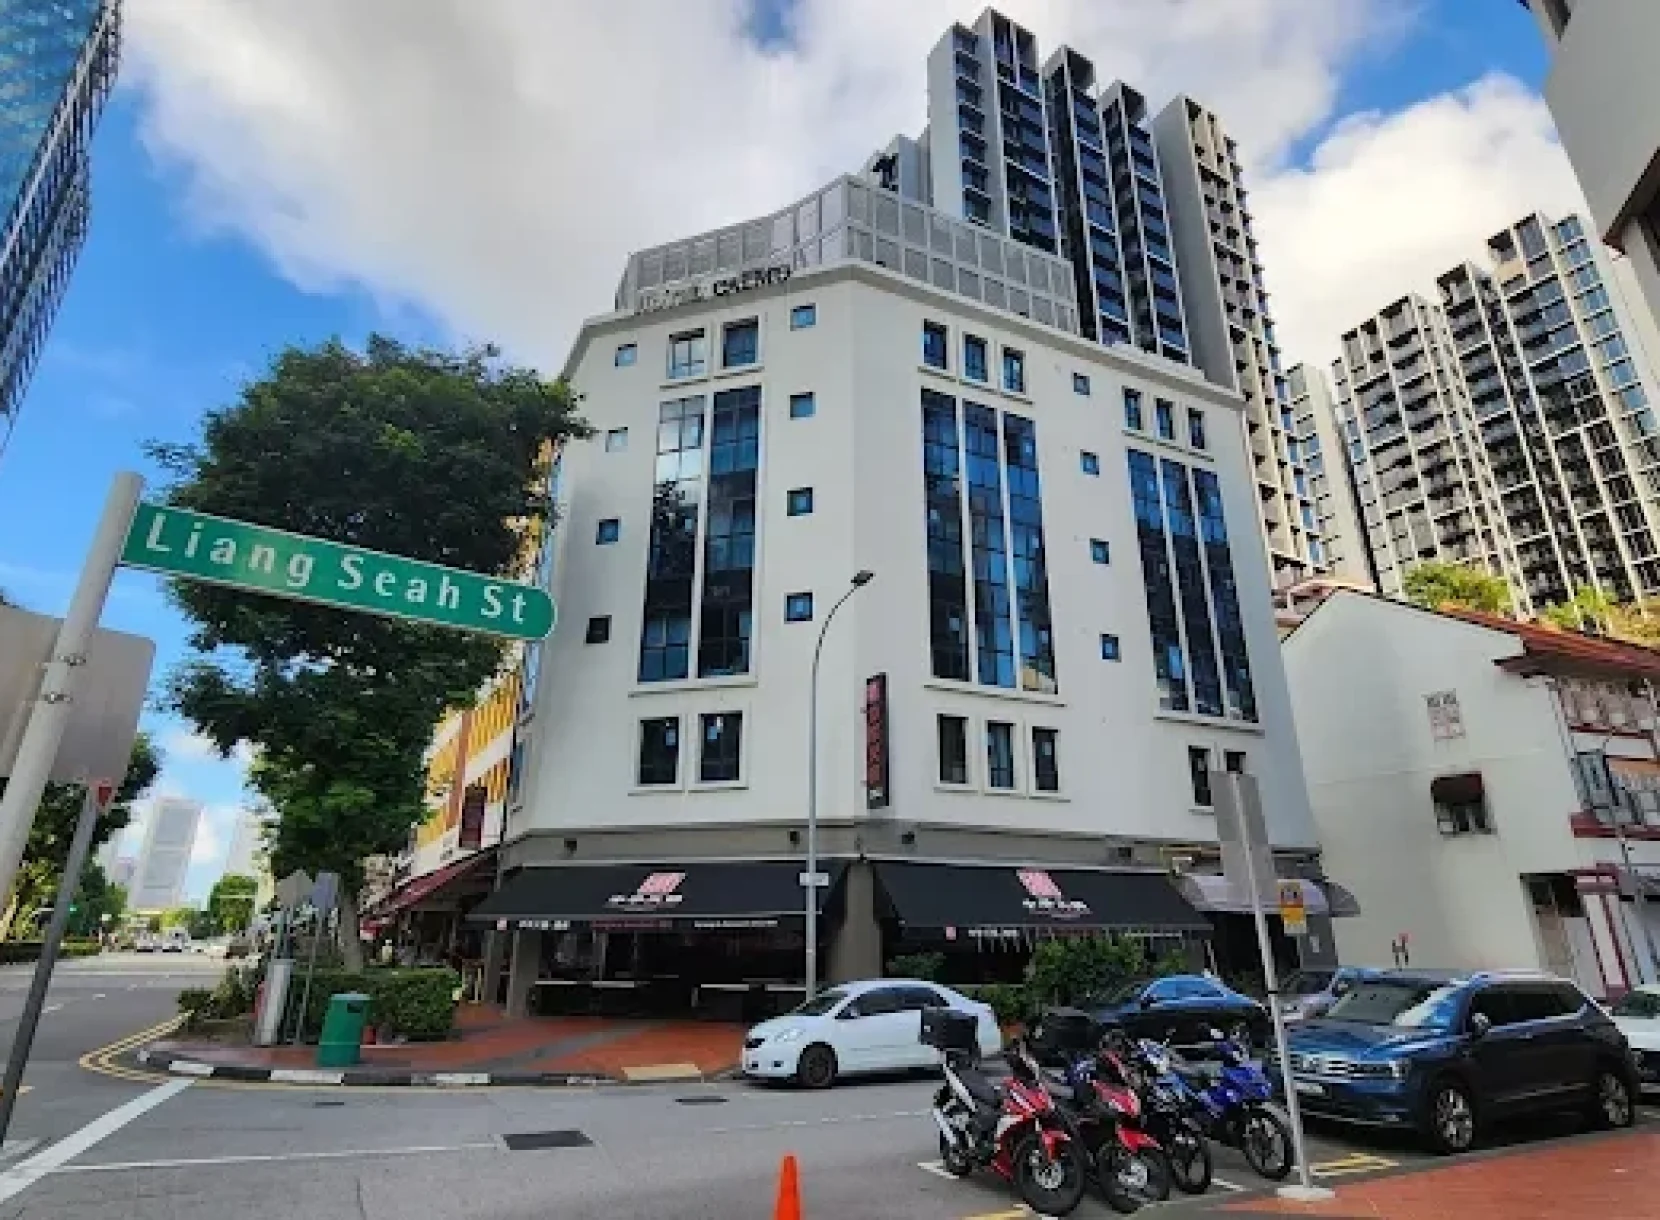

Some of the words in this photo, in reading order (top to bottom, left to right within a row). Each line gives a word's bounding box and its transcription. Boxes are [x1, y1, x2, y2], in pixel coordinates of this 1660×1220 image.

[145, 513, 315, 588] Liang
[337, 554, 460, 610] Seah
[480, 585, 528, 625] St
